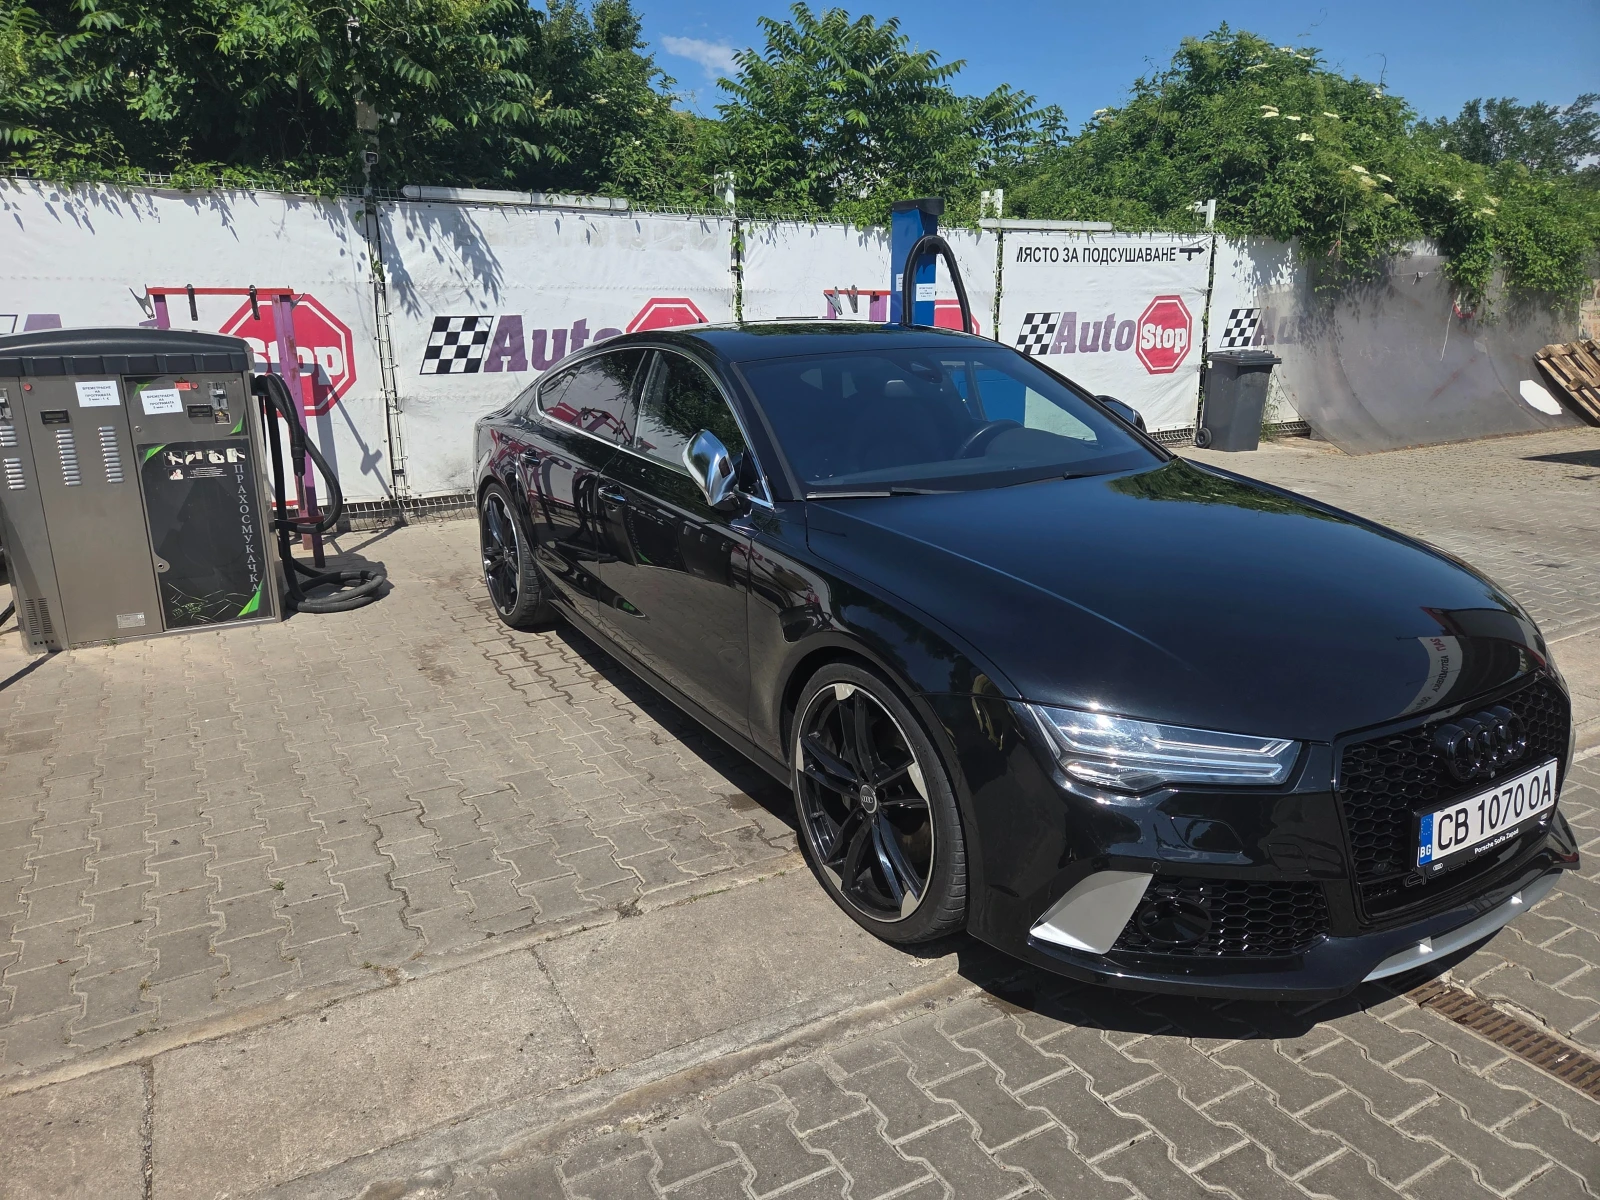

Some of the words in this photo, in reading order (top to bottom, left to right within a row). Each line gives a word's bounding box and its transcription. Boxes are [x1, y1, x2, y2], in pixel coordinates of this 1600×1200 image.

[1062, 247, 1079, 263] ЗА
[1082, 246, 1176, 266] ПОДСУШАВАНЕ
[1050, 311, 1136, 354] Auto
[1141, 323, 1187, 354] Stop
[234, 464, 261, 592] ПРАХОСМУКАЧКА
[1437, 807, 1470, 851] CB
[1477, 783, 1525, 835] 1070
[1528, 770, 1552, 810] OA
[1420, 844, 1432, 858] BG
[1474, 842, 1494, 855] Porsche
[1493, 835, 1506, 846] Sofia
